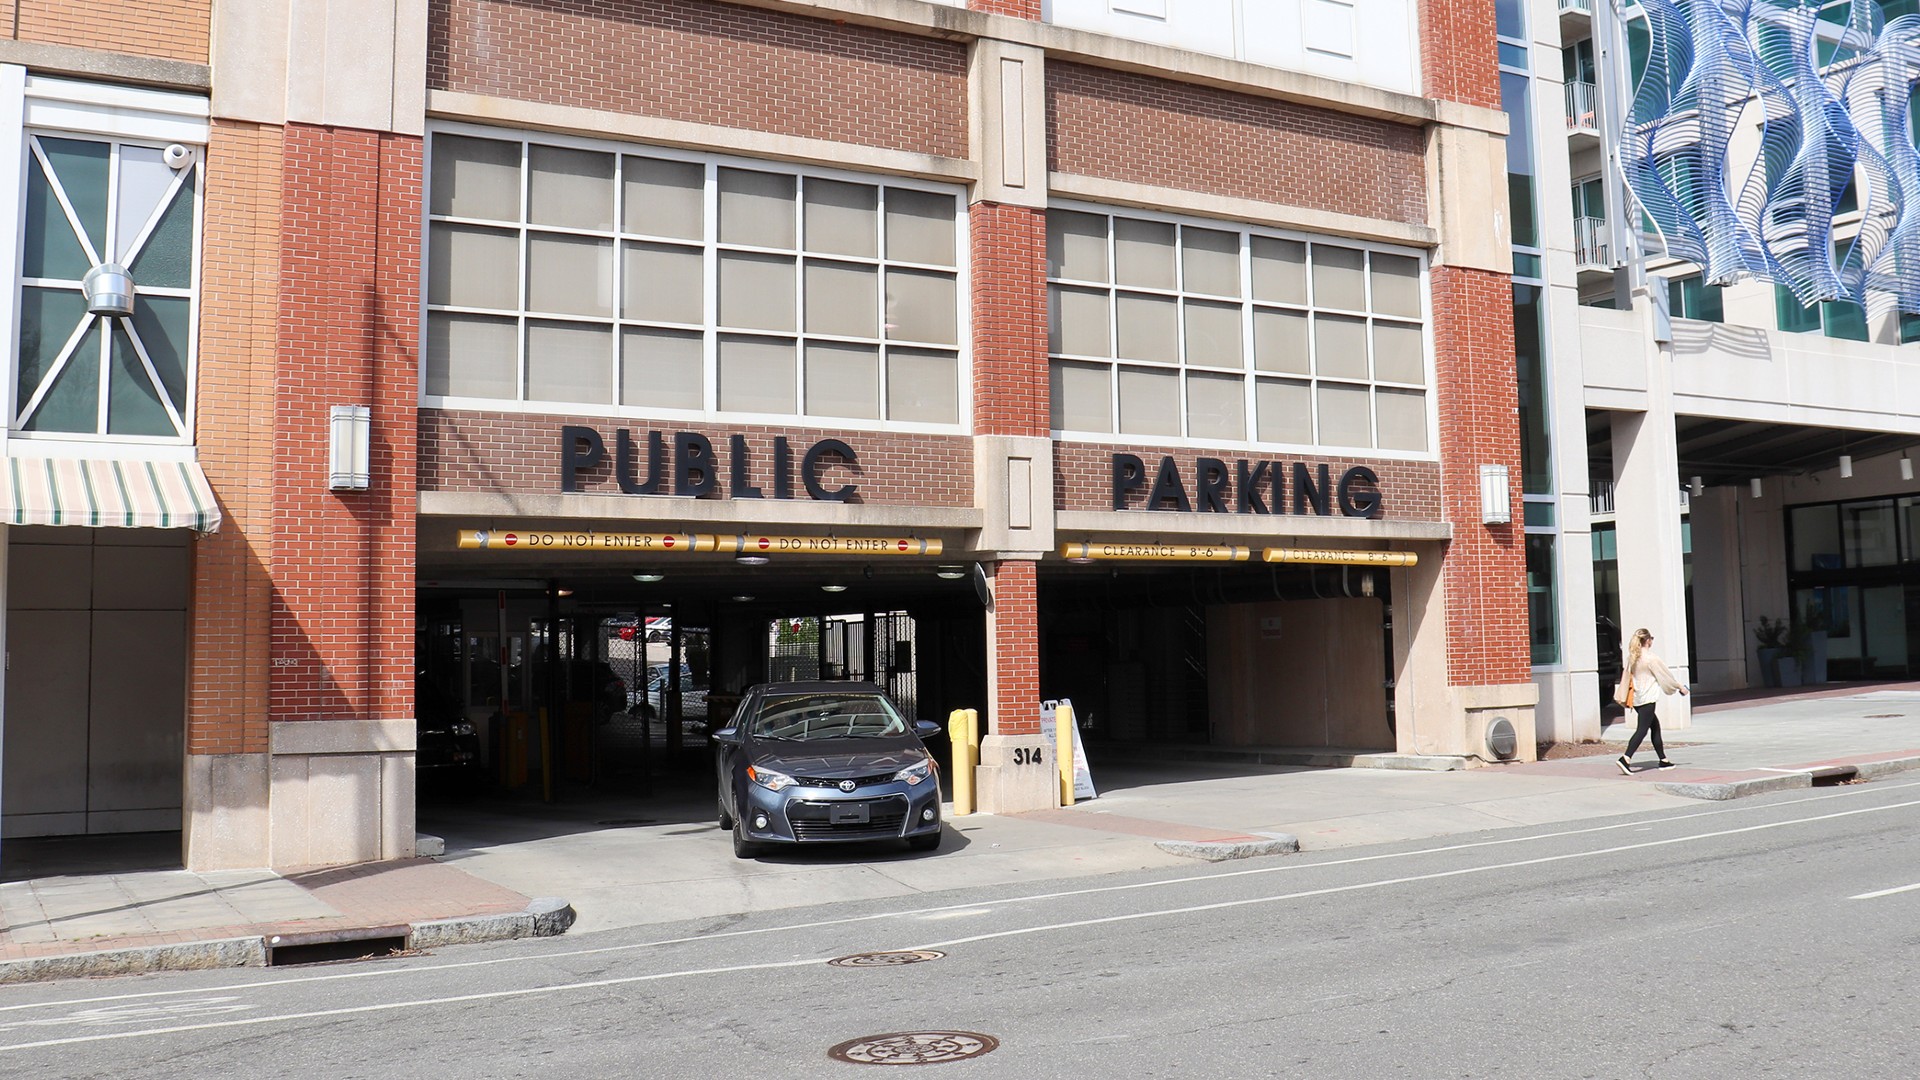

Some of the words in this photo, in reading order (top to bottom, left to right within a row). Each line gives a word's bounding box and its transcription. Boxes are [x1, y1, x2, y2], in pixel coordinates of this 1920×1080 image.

[561, 425, 857, 501] PUBLIC
[1112, 453, 1382, 519] PARKING
[529, 534, 554, 546] DO
[563, 535, 596, 547] NOT
[604, 535, 653, 547] ENTER
[780, 538, 802, 550] DO
[810, 538, 839, 550] NOT
[846, 539, 888, 551] ENTER
[1103, 545, 1176, 557] CLEARANCE
[1293, 550, 1355, 561] CLEARANCE
[1014, 747, 1042, 765] 314
